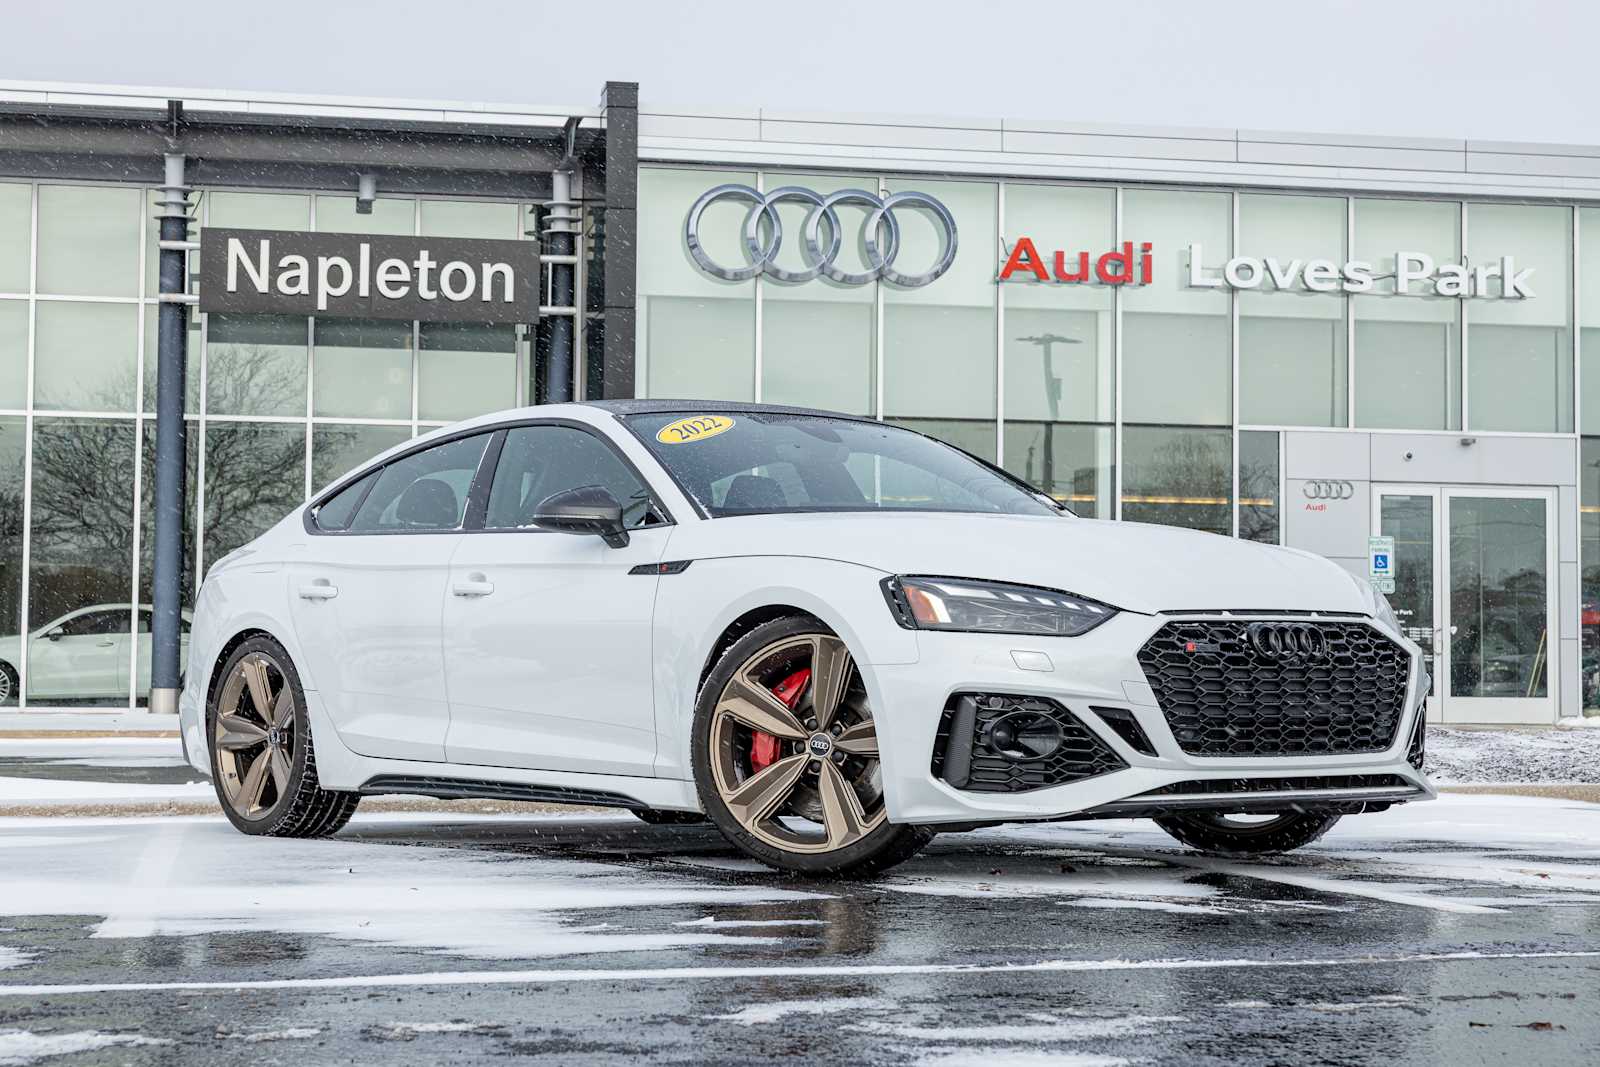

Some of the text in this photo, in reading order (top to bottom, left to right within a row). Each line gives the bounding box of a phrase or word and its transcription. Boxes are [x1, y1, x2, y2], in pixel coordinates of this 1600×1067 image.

[226, 237, 515, 311] Napleton
[999, 237, 1537, 298] Audi Loves Park
[670, 417, 722, 440] 2022
[1305, 503, 1327, 512] Audi
